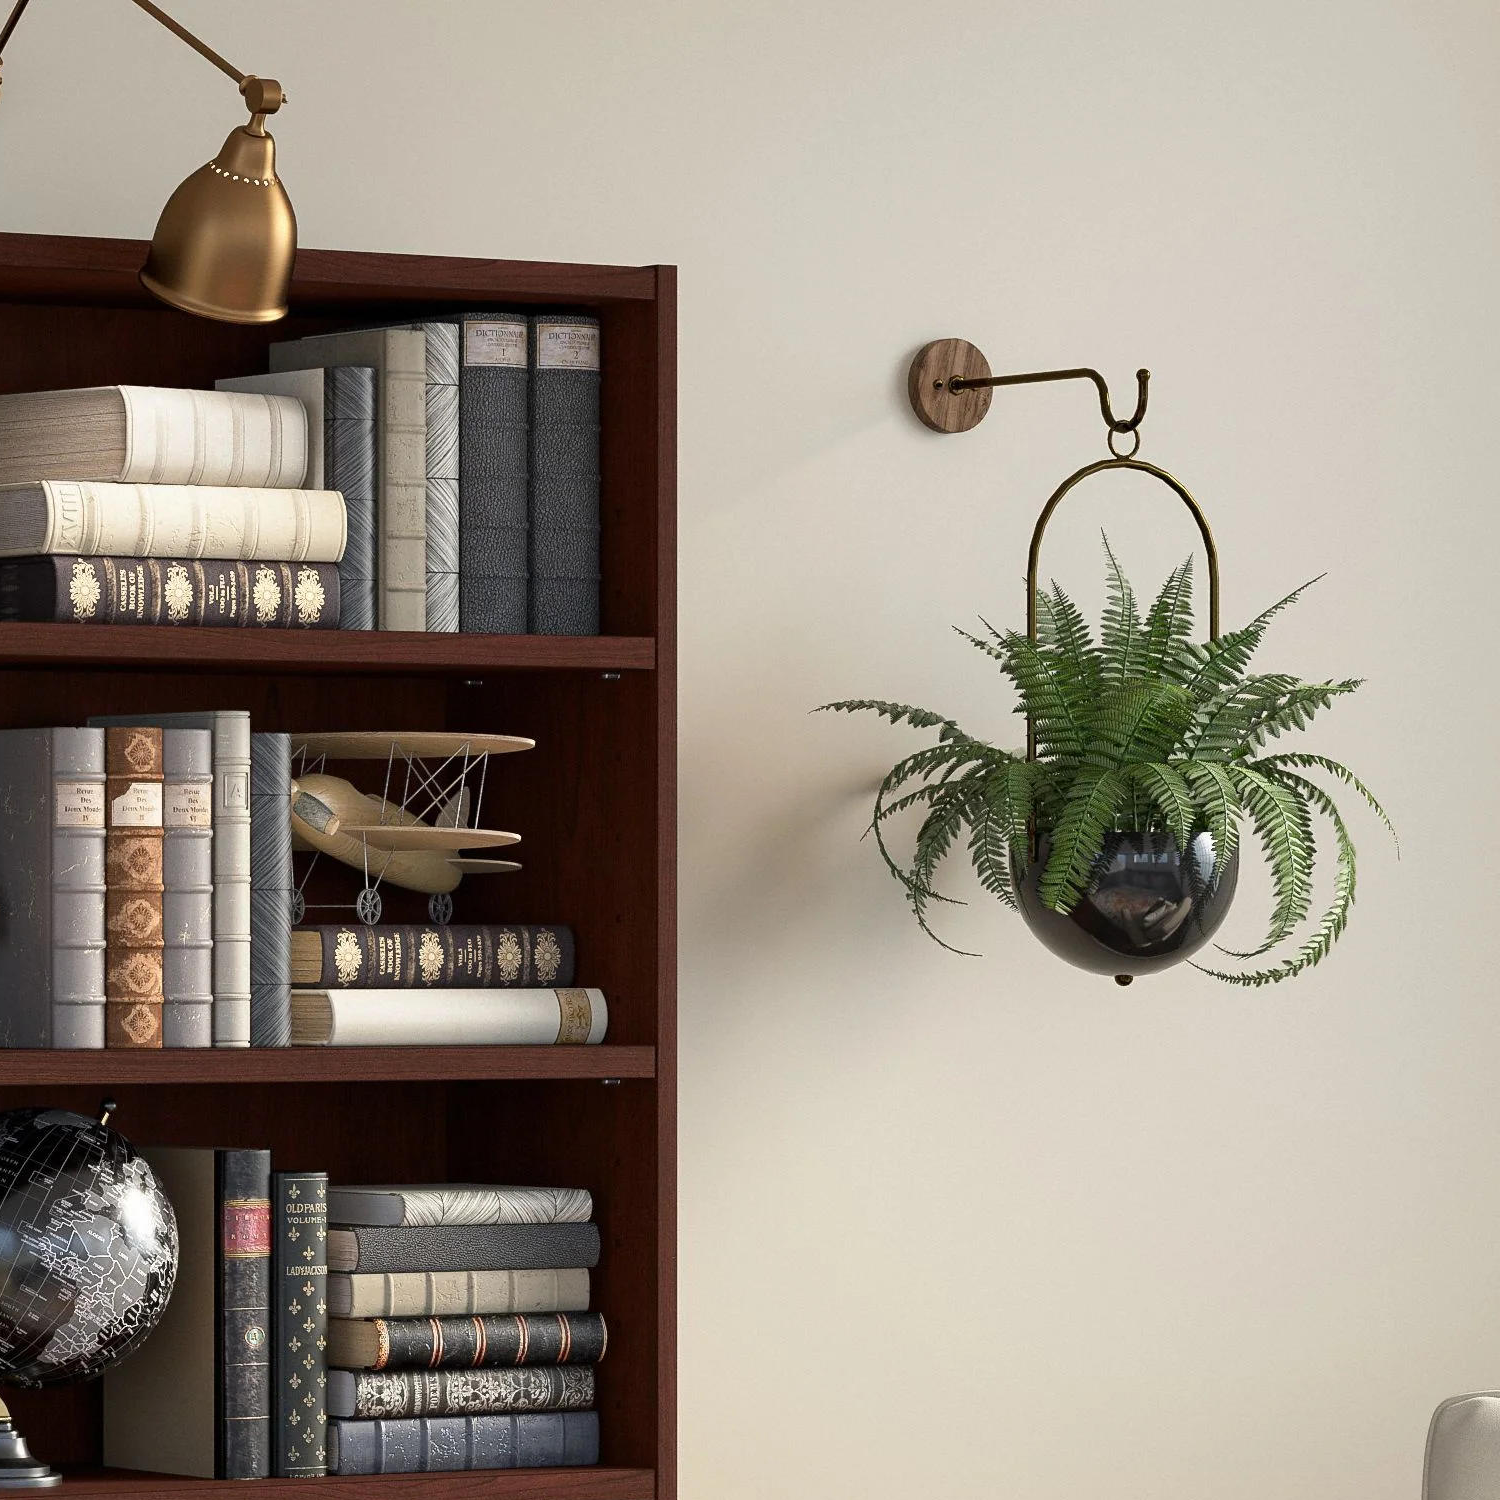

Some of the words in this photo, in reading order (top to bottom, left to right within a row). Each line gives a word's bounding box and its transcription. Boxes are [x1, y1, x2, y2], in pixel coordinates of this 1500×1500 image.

[128, 571, 136, 584] OF
[128, 584, 136, 610] BOOK
[136, 564, 145, 618] KNOWLEDGE
[80, 796, 92, 804] Des
[285, 1203, 303, 1214] OLD
[304, 1203, 327, 1213] PARIS
[429, 1376, 439, 1409] POEMS
